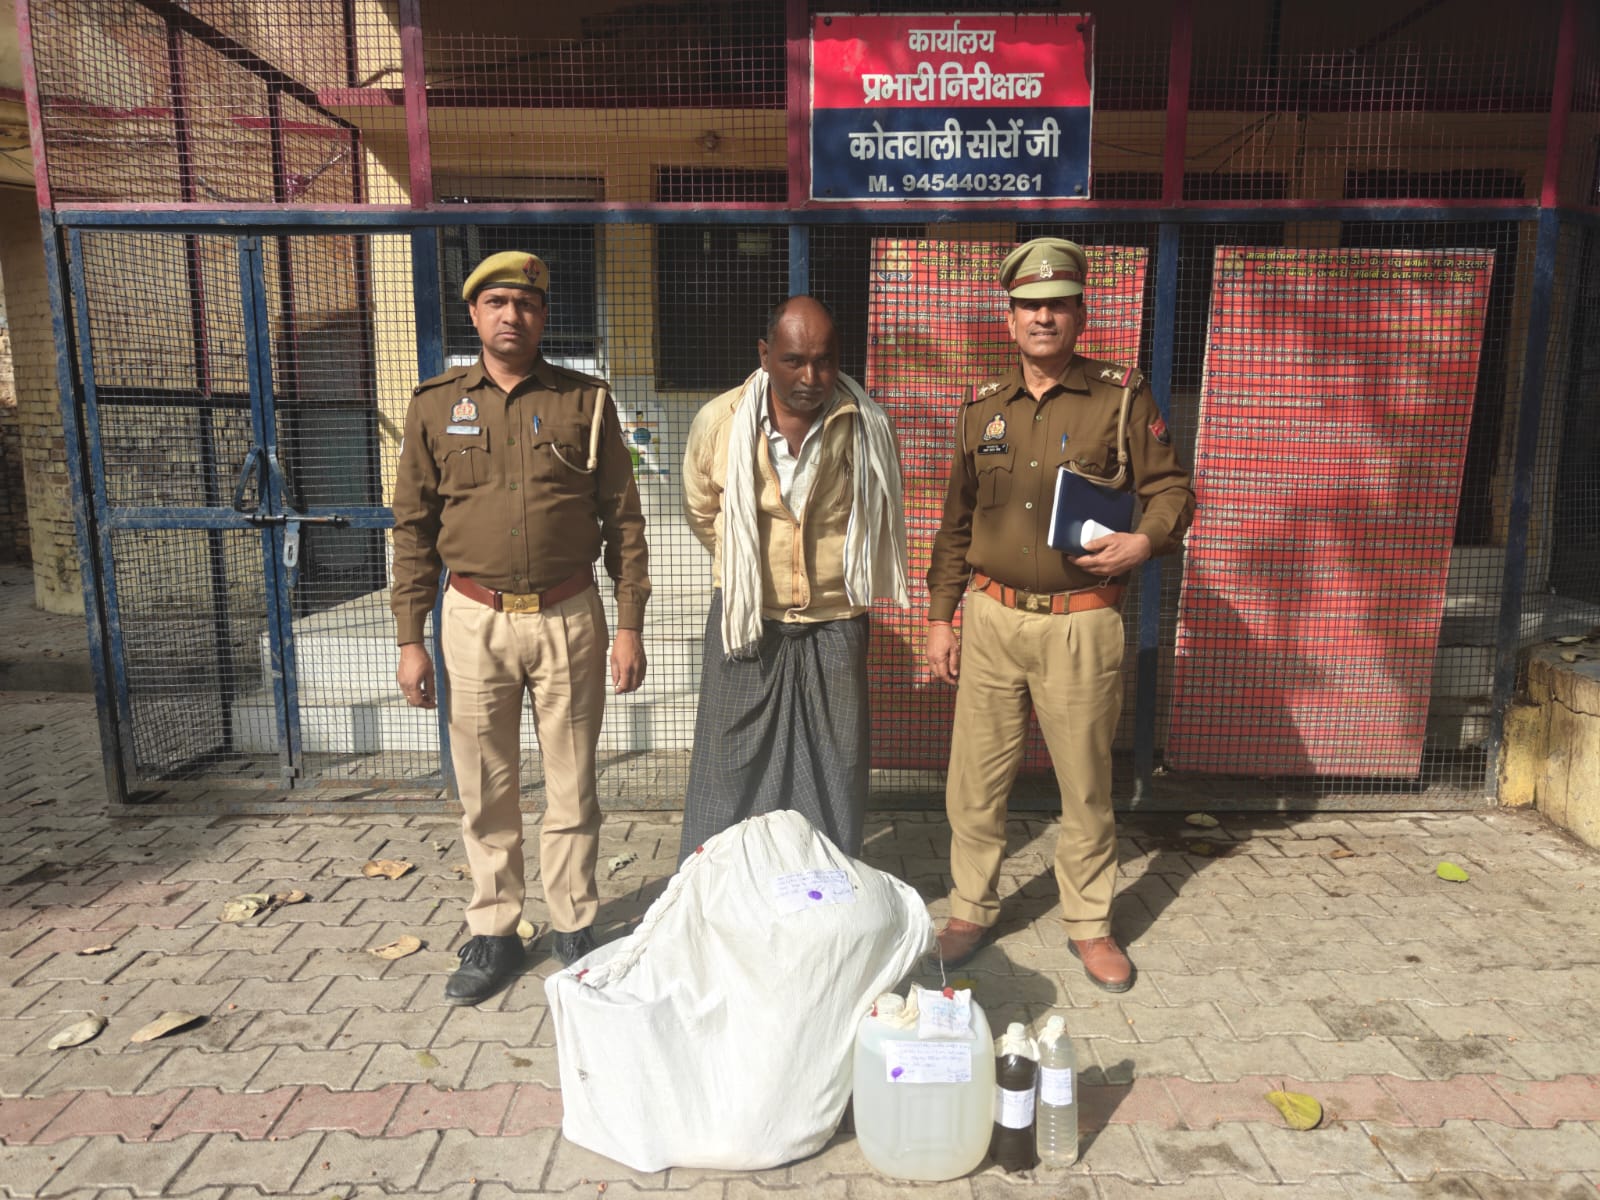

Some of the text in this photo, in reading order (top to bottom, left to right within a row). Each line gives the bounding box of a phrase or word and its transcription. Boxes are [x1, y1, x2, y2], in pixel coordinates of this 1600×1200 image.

[908, 20, 996, 54] कार्यालय
[862, 62, 1044, 104] प्रभारी निरीक्षक
[849, 117, 1061, 160] कोतवाली सोरों जी
[869, 174, 1042, 192] M. 9454403261
